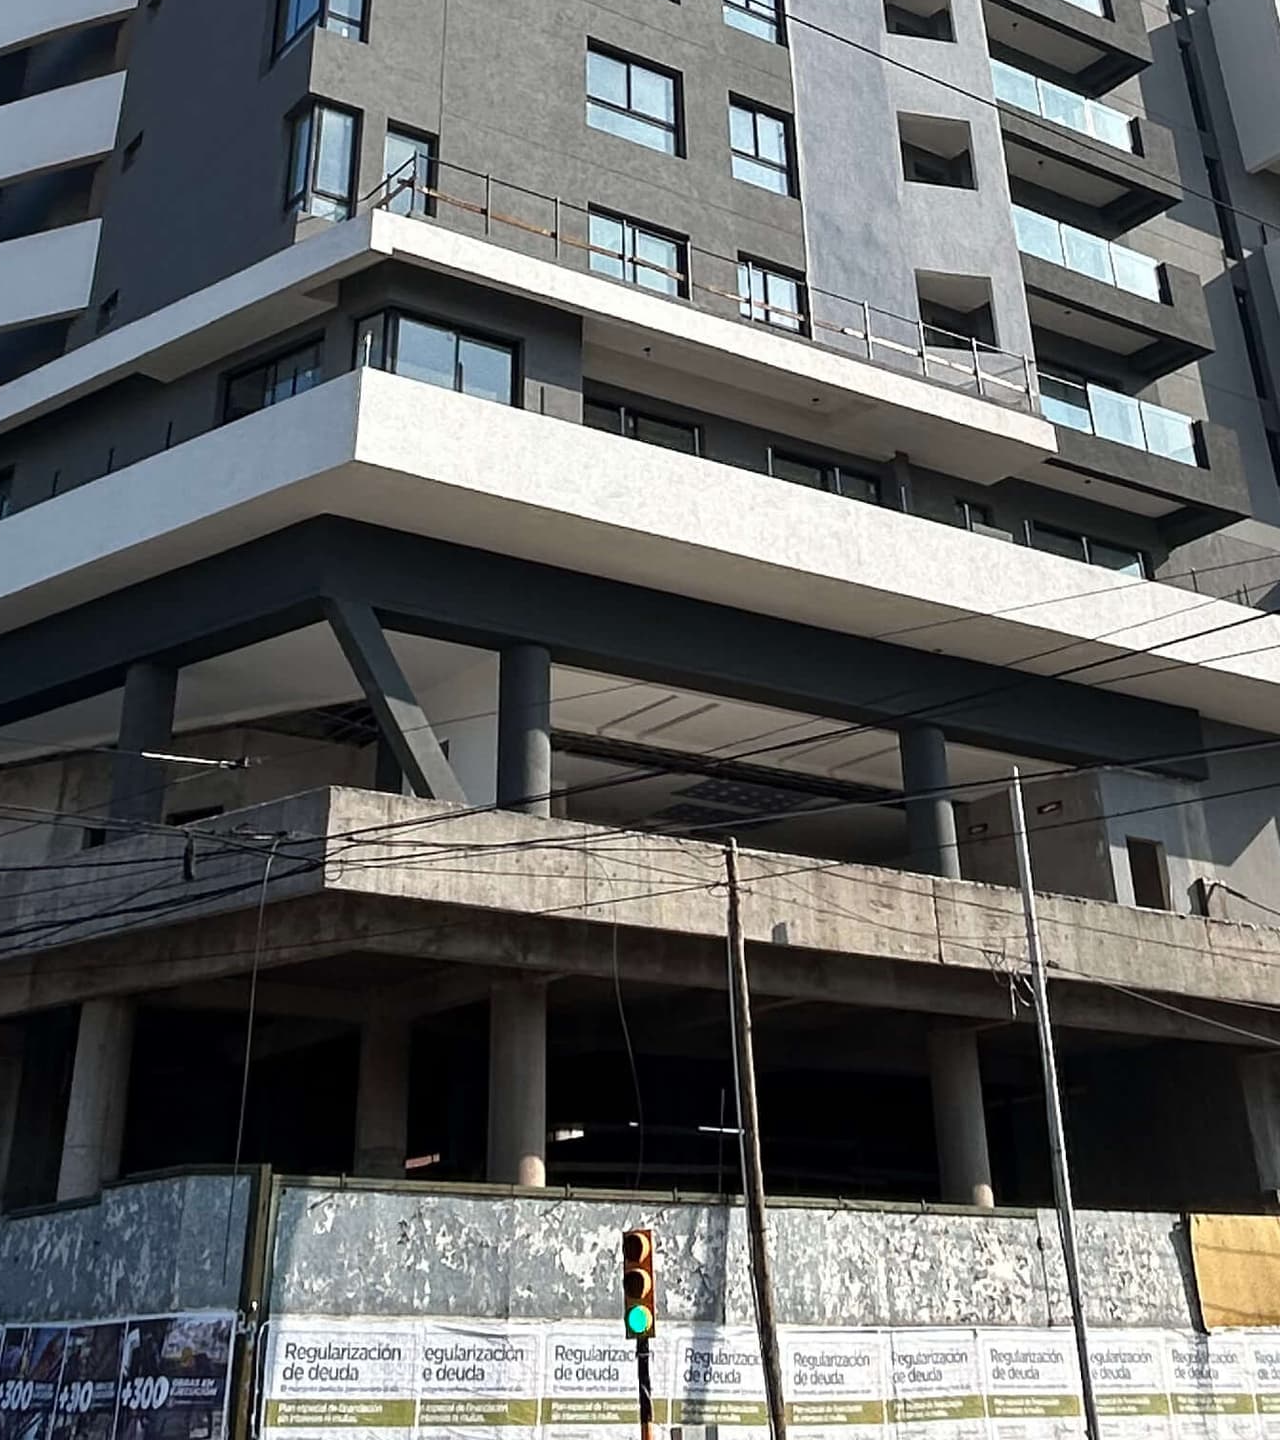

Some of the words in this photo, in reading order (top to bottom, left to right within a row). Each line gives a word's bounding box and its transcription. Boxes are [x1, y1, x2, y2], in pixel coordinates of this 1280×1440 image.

[285, 1342, 402, 1363] Regularización
[422, 1344, 524, 1364] egularización
[555, 1345, 655, 1364] Regularizacn
[794, 1351, 870, 1370] Regularización
[990, 1348, 1064, 1366] Regularización
[1090, 1350, 1153, 1366] egularización
[282, 1363, 304, 1381] de
[308, 1363, 360, 1381] deuda
[422, 1367, 432, 1381] e
[436, 1363, 485, 1381] deuda
[554, 1365, 573, 1381] de
[576, 1364, 620, 1381] deuda
[683, 1367, 701, 1383] de
[704, 1366, 741, 1384] deuda
[794, 1370, 808, 1386] de
[811, 1370, 845, 1386] deuda
[907, 1367, 943, 1383] deuda
[992, 1366, 1007, 1380] de
[1008, 1366, 1040, 1380] deuda
[1100, 1366, 1132, 1380] deuda
[121, 1375, 170, 1410] +300
